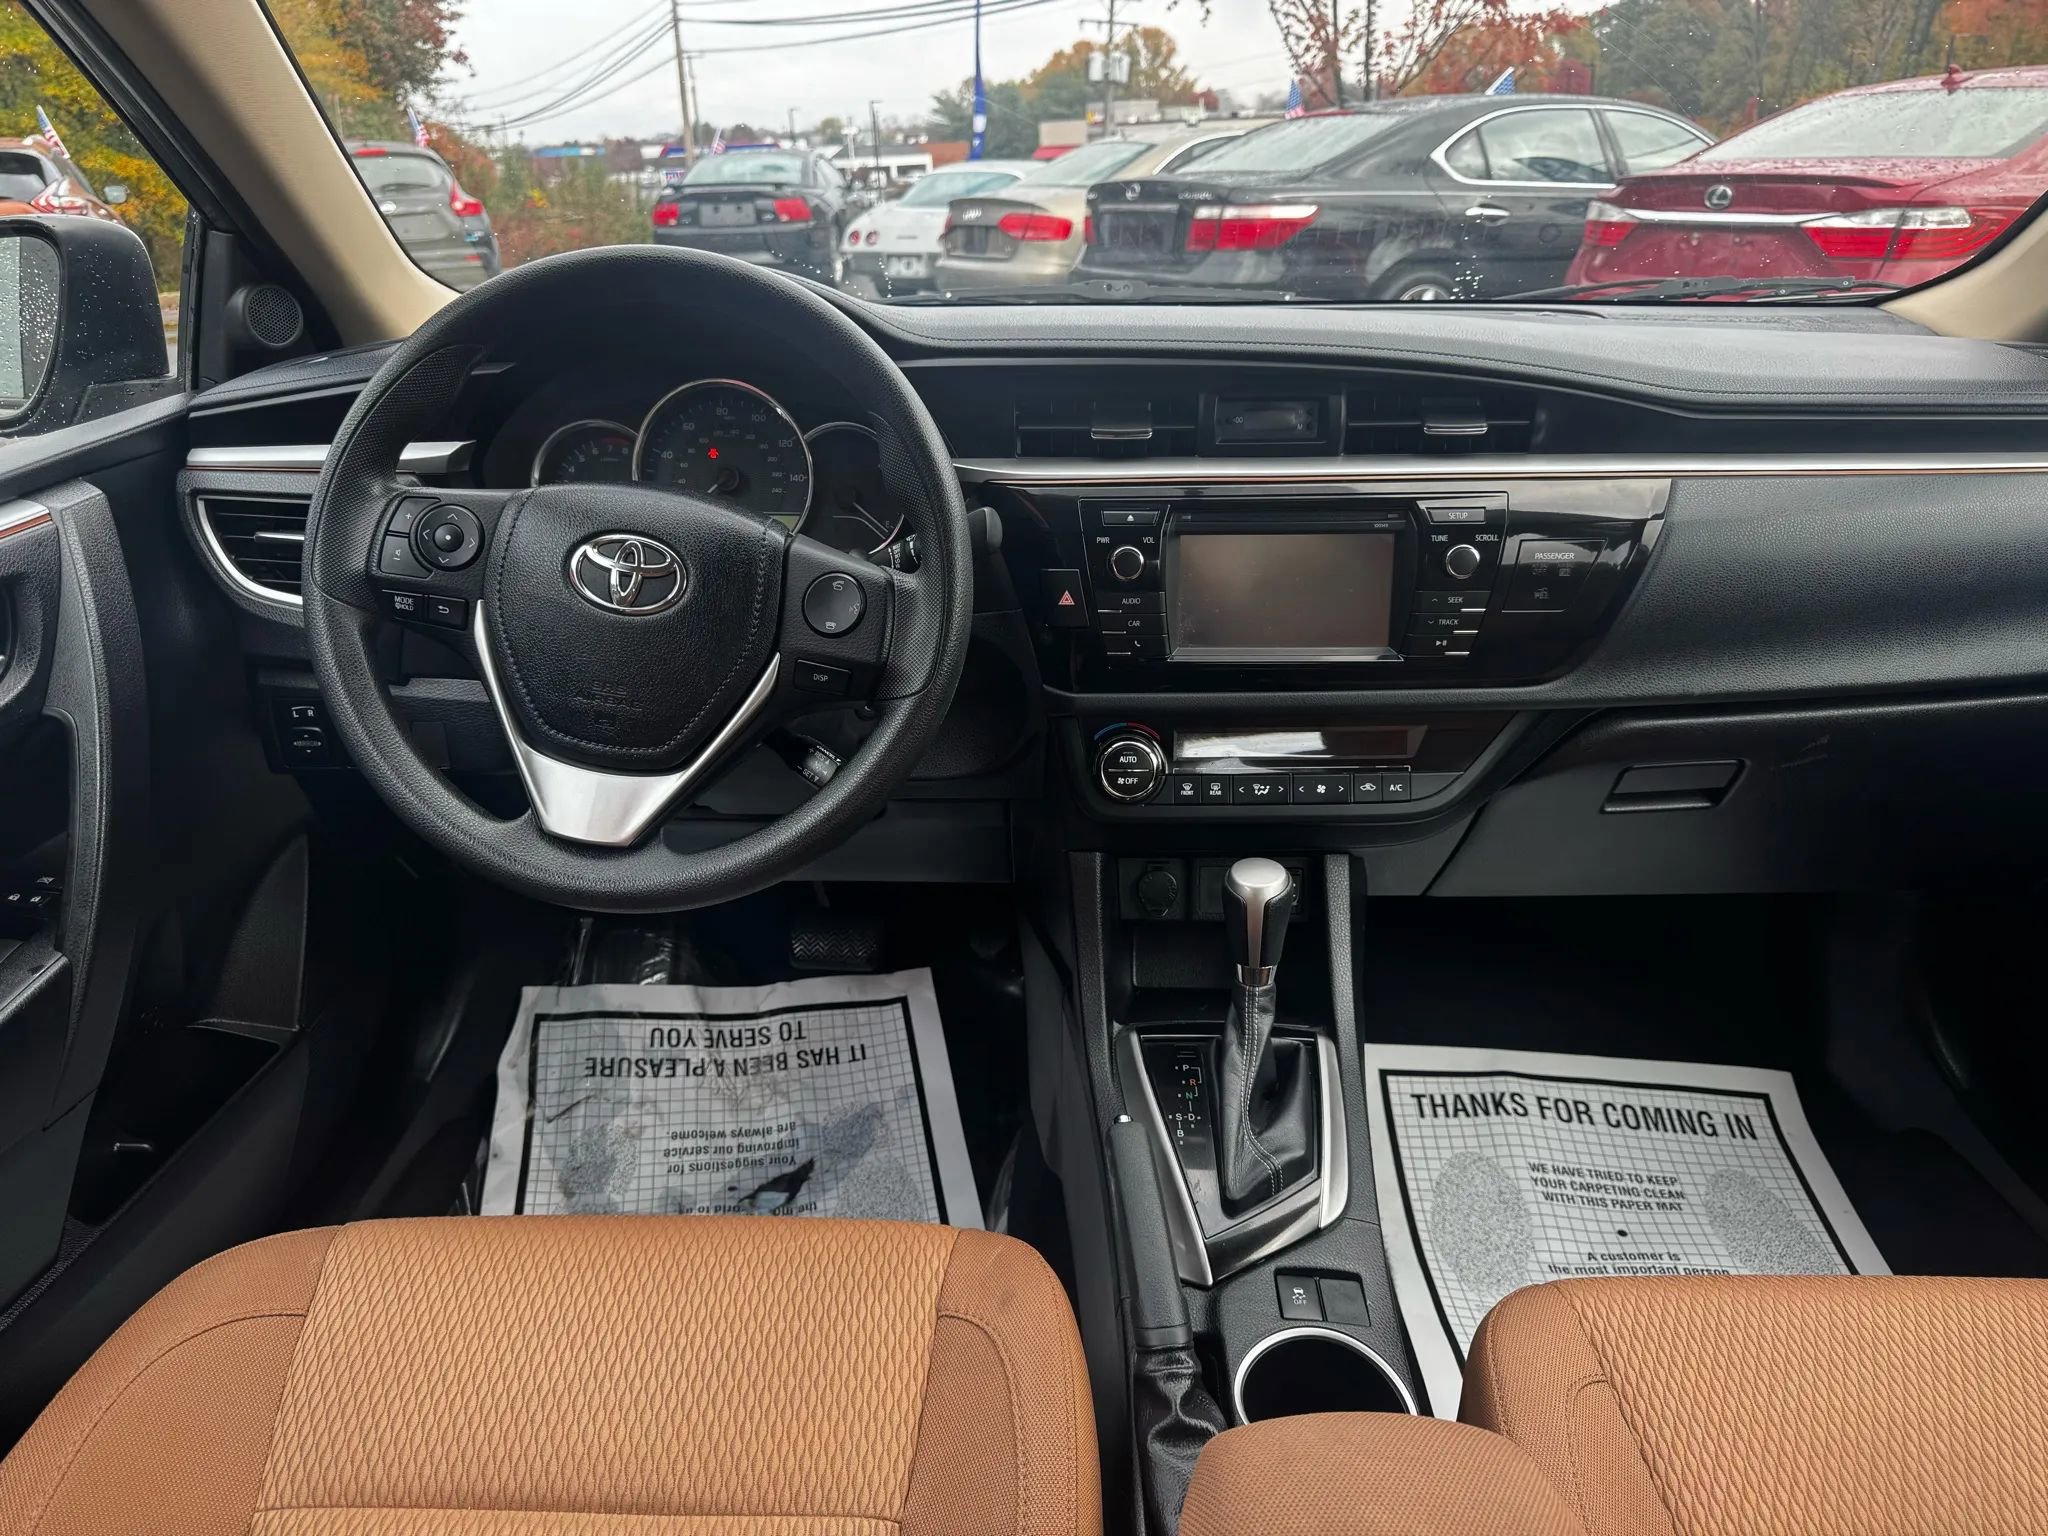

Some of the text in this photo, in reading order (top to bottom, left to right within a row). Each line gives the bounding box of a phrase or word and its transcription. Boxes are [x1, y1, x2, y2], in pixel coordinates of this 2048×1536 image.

[716, 407, 728, 416] 80
[752, 414, 766, 422] 100
[778, 440, 793, 448] 120
[661, 451, 673, 459] 40
[790, 474, 804, 482] 140
[1475, 534, 1500, 542] SCROLL
[1534, 552, 1575, 560] PASSENGER
[394, 595, 414, 605] MODE
[813, 673, 829, 682] DISP
[1389, 784, 1403, 792] A/C
[650, 1020, 807, 1049] TO SERVE YOU
[584, 1043, 867, 1079] IT HAS BEEN A PLEASURE
[1189, 1078, 1196, 1086] R
[1176, 1113, 1195, 1121] S D
[1410, 1091, 1758, 1140] THANKS FOR COMING IN
[777, 1121, 797, 1131] are
[731, 1126, 773, 1138] always
[1177, 1129, 1184, 1137] B
[664, 1138, 800, 1158] improving our service
[667, 1155, 797, 1175] Your suggestions for
[1528, 1161, 1678, 1187] WE HAVE TRIED TO KEEP
[1530, 1176, 1686, 1200] YOUR CARPETING CLEAN
[1542, 1191, 1684, 1212] WITH THIS PAPER MAT
[1587, 1252, 1681, 1261] A customer is
[1548, 1264, 1570, 1274] the
[1574, 1265, 1609, 1275] most
[1613, 1264, 1680, 1276] important
